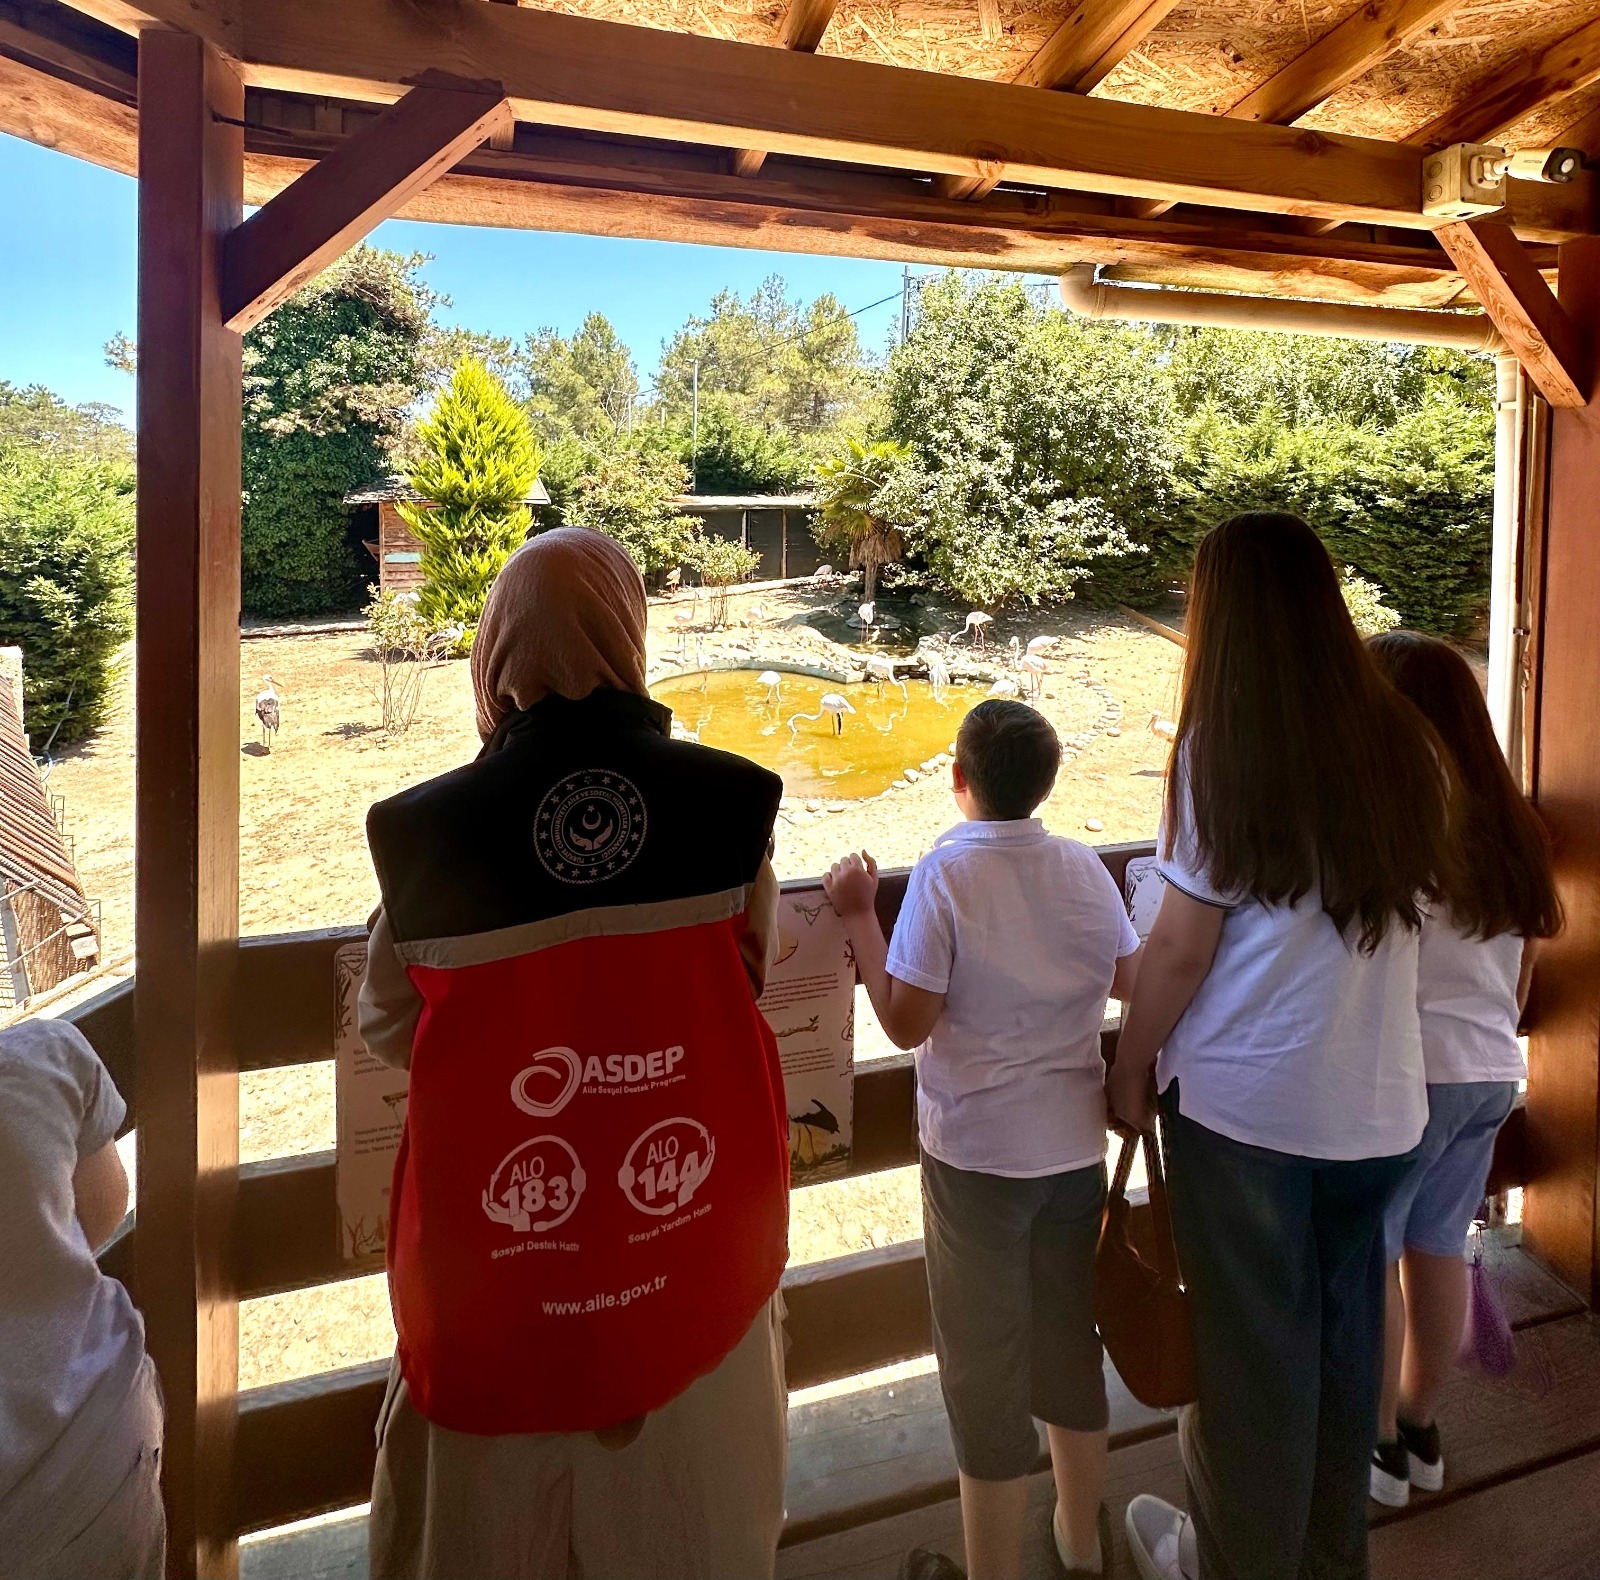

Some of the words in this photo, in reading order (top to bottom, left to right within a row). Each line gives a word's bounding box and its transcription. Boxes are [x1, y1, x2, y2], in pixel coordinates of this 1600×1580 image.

[582, 1045, 685, 1083] ASDEP
[582, 1085, 597, 1094] Aile
[598, 1085, 622, 1096] Sosyal
[624, 1083, 650, 1094] Destek
[646, 1135, 679, 1166] ALO
[509, 1156, 545, 1187] ALO
[637, 1150, 702, 1201] 144
[500, 1175, 569, 1218] 183
[491, 1242, 525, 1259] Sosyal
[526, 1240, 558, 1251] Destek
[627, 1226, 660, 1244] Sosyal
[541, 1275, 667, 1316] www.aile.gov.tr
